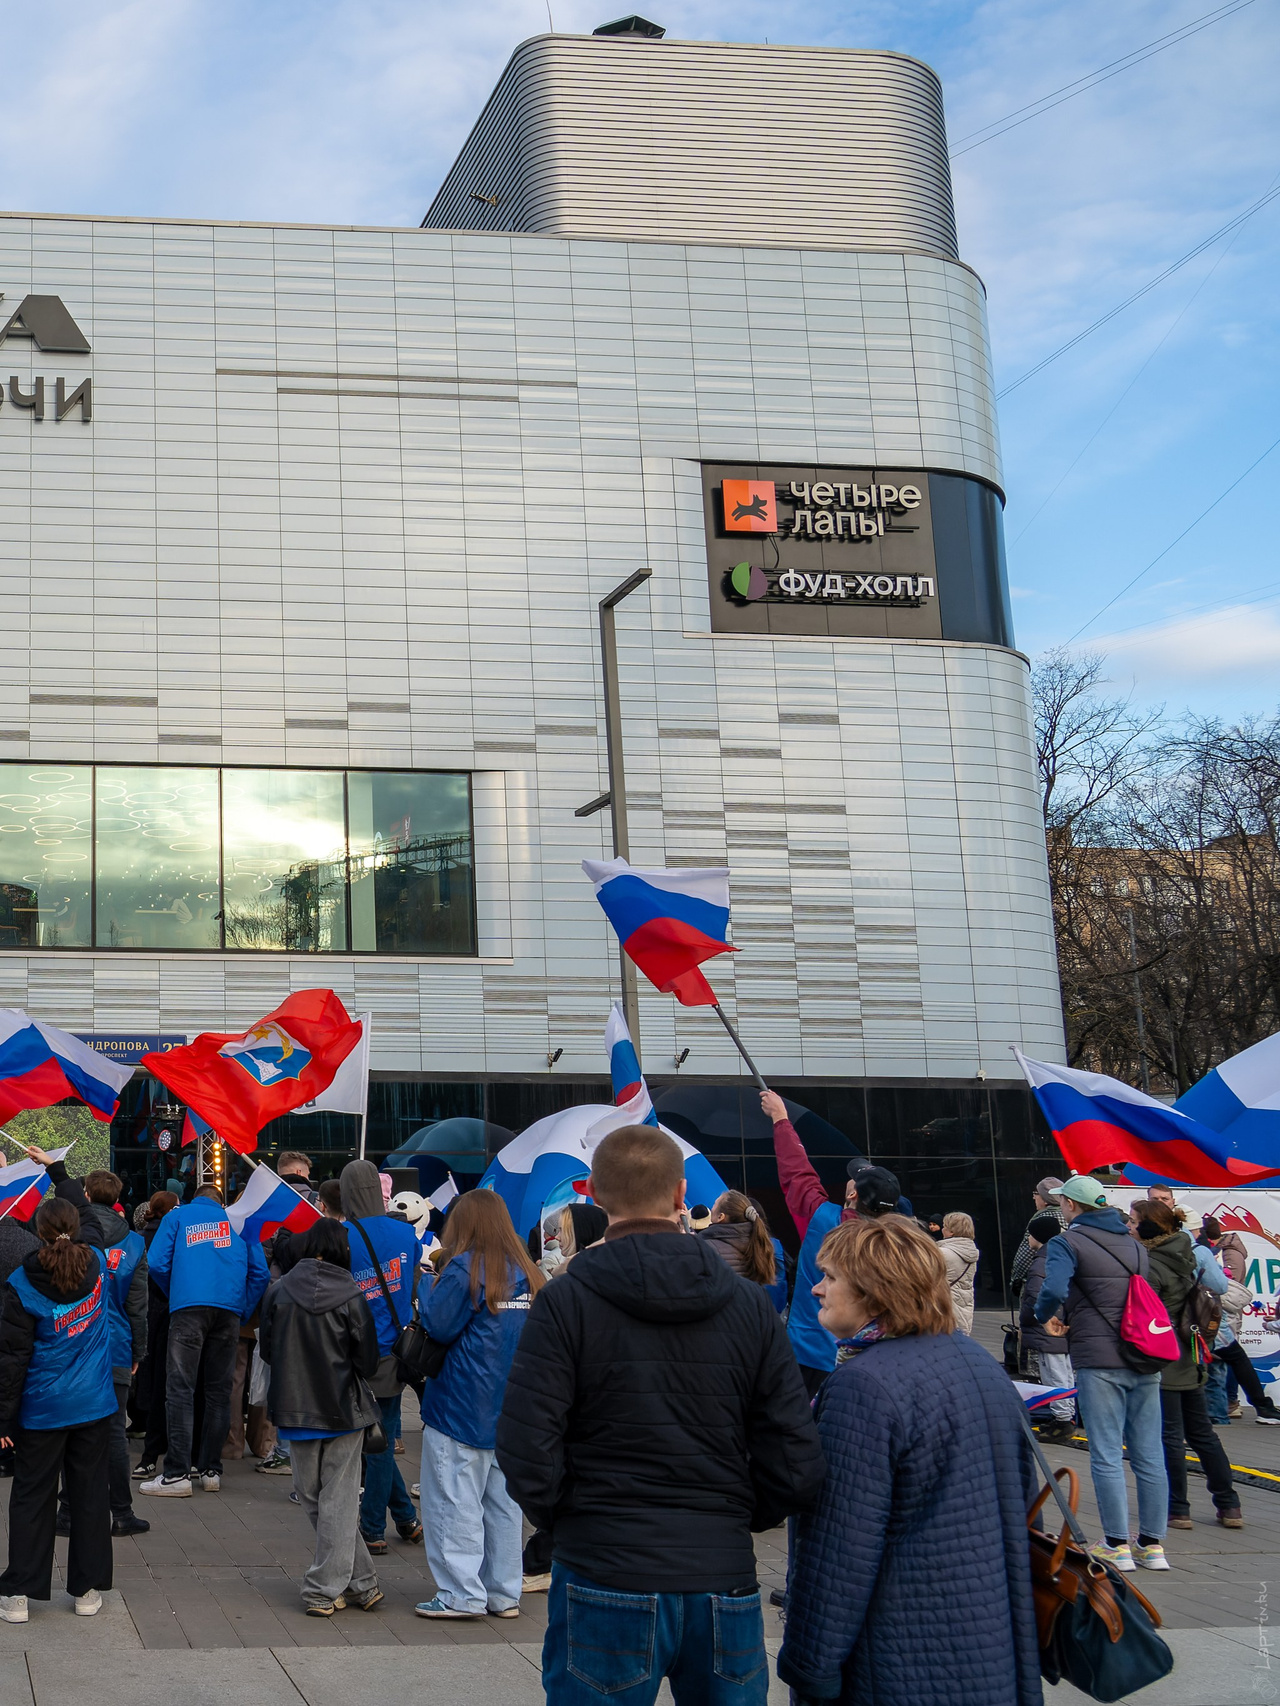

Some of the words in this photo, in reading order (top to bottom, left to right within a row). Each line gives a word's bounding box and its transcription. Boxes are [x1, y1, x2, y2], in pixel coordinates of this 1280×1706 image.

[790, 481, 922, 509] четыре
[791, 510, 886, 537] лапы
[778, 568, 935, 598] фуд-холл
[86, 1041, 150, 1051] НДРОПОВА
[214, 1239, 231, 1248] ЮАО
